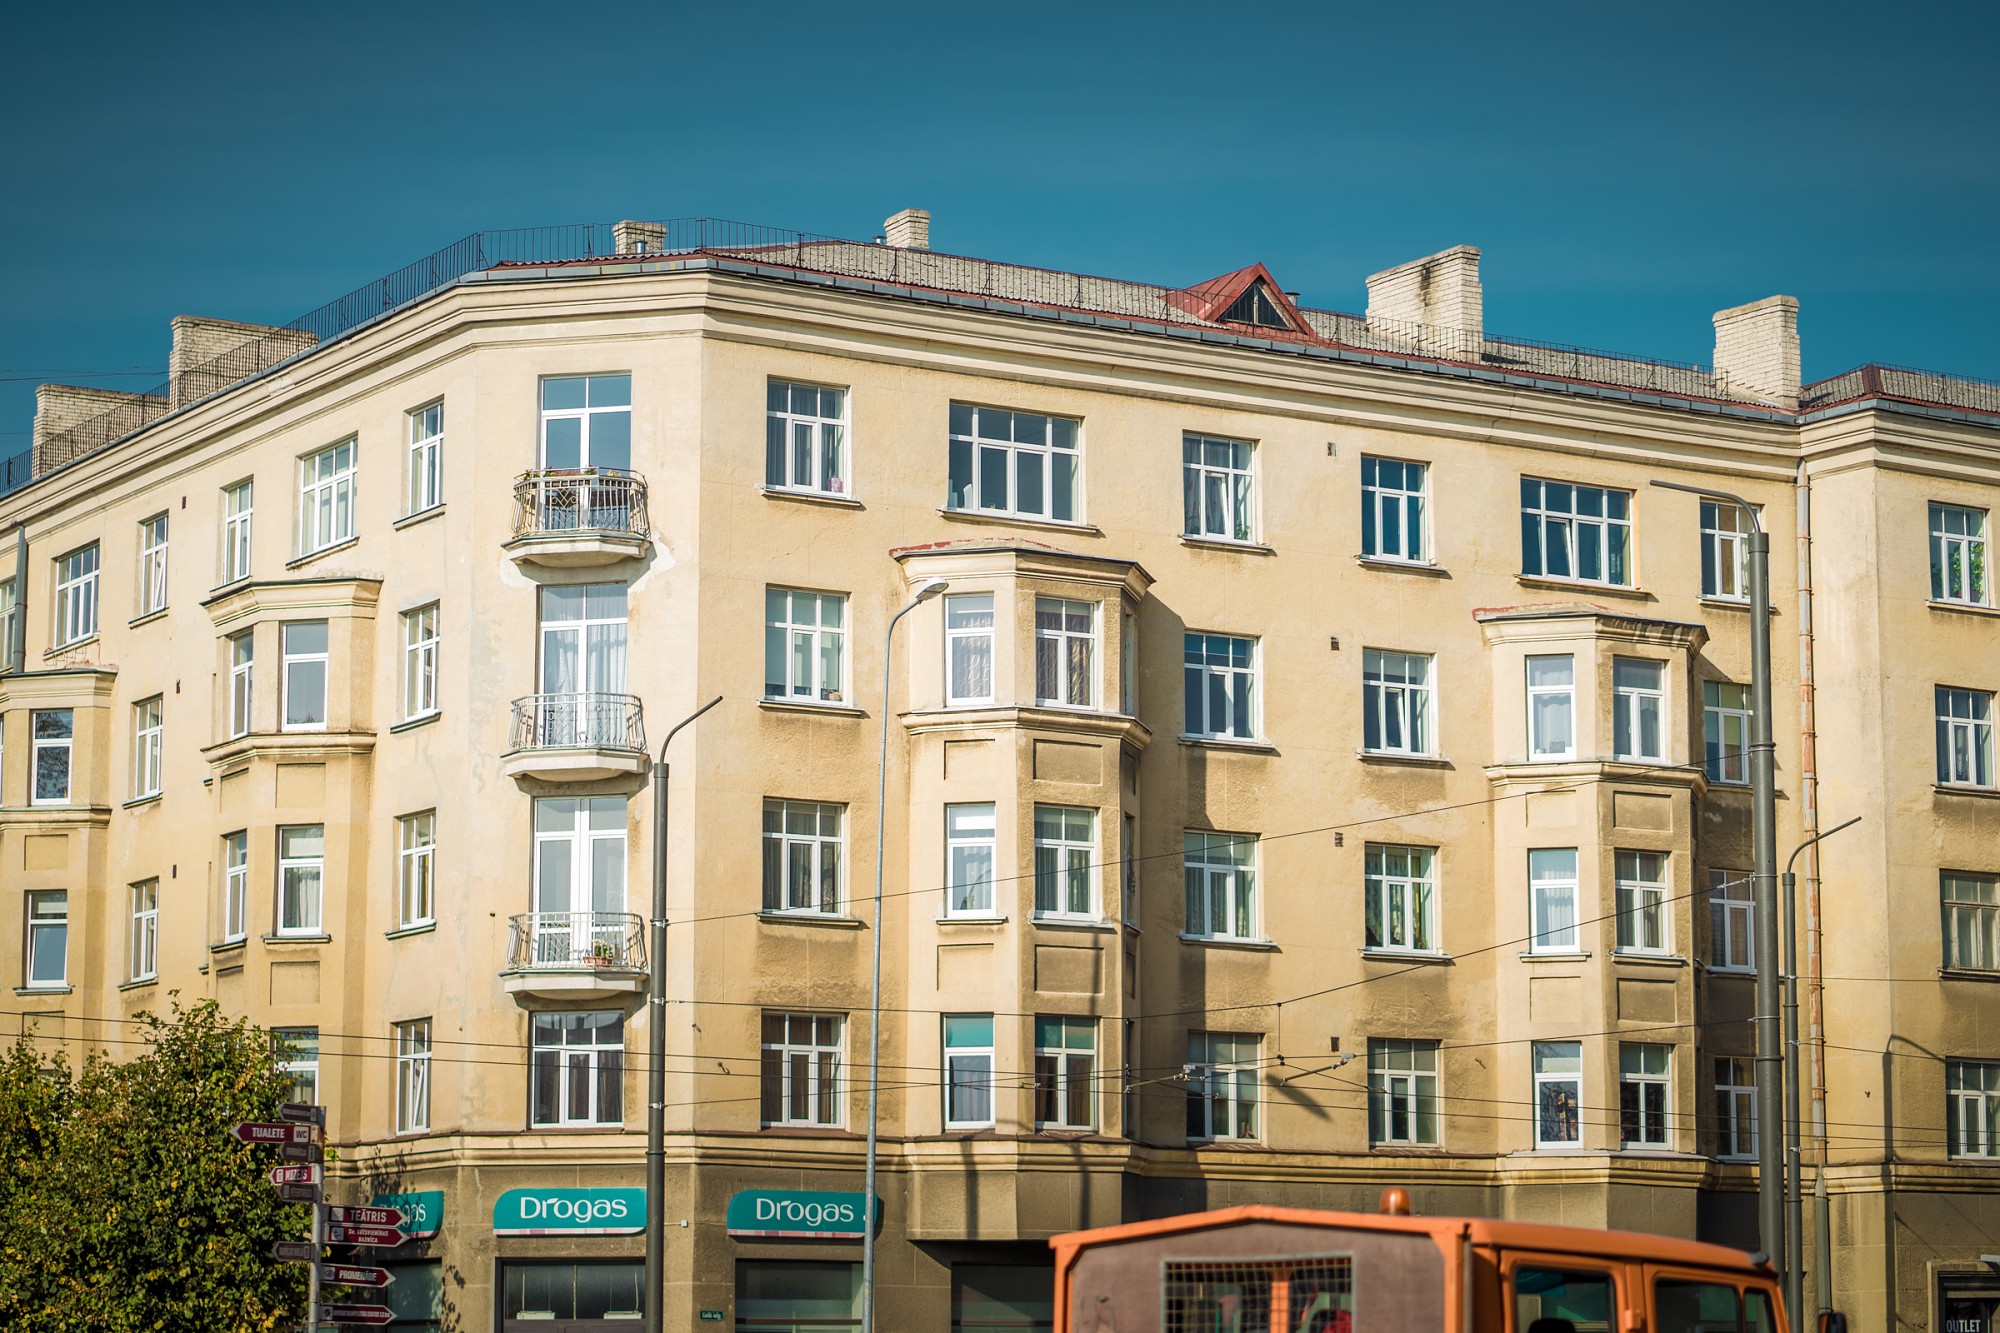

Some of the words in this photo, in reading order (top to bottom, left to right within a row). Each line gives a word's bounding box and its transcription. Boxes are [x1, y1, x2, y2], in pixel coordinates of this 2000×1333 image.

[252, 1127, 285, 1139] TUALETE
[296, 1130, 307, 1139] WC
[350, 1208, 387, 1223] TEĀTRIS
[520, 1196, 628, 1224] Drogas
[756, 1198, 854, 1227] Drogas
[339, 1269, 378, 1282] PROMENĀDE
[1946, 1319, 1981, 1333] OUTLET
